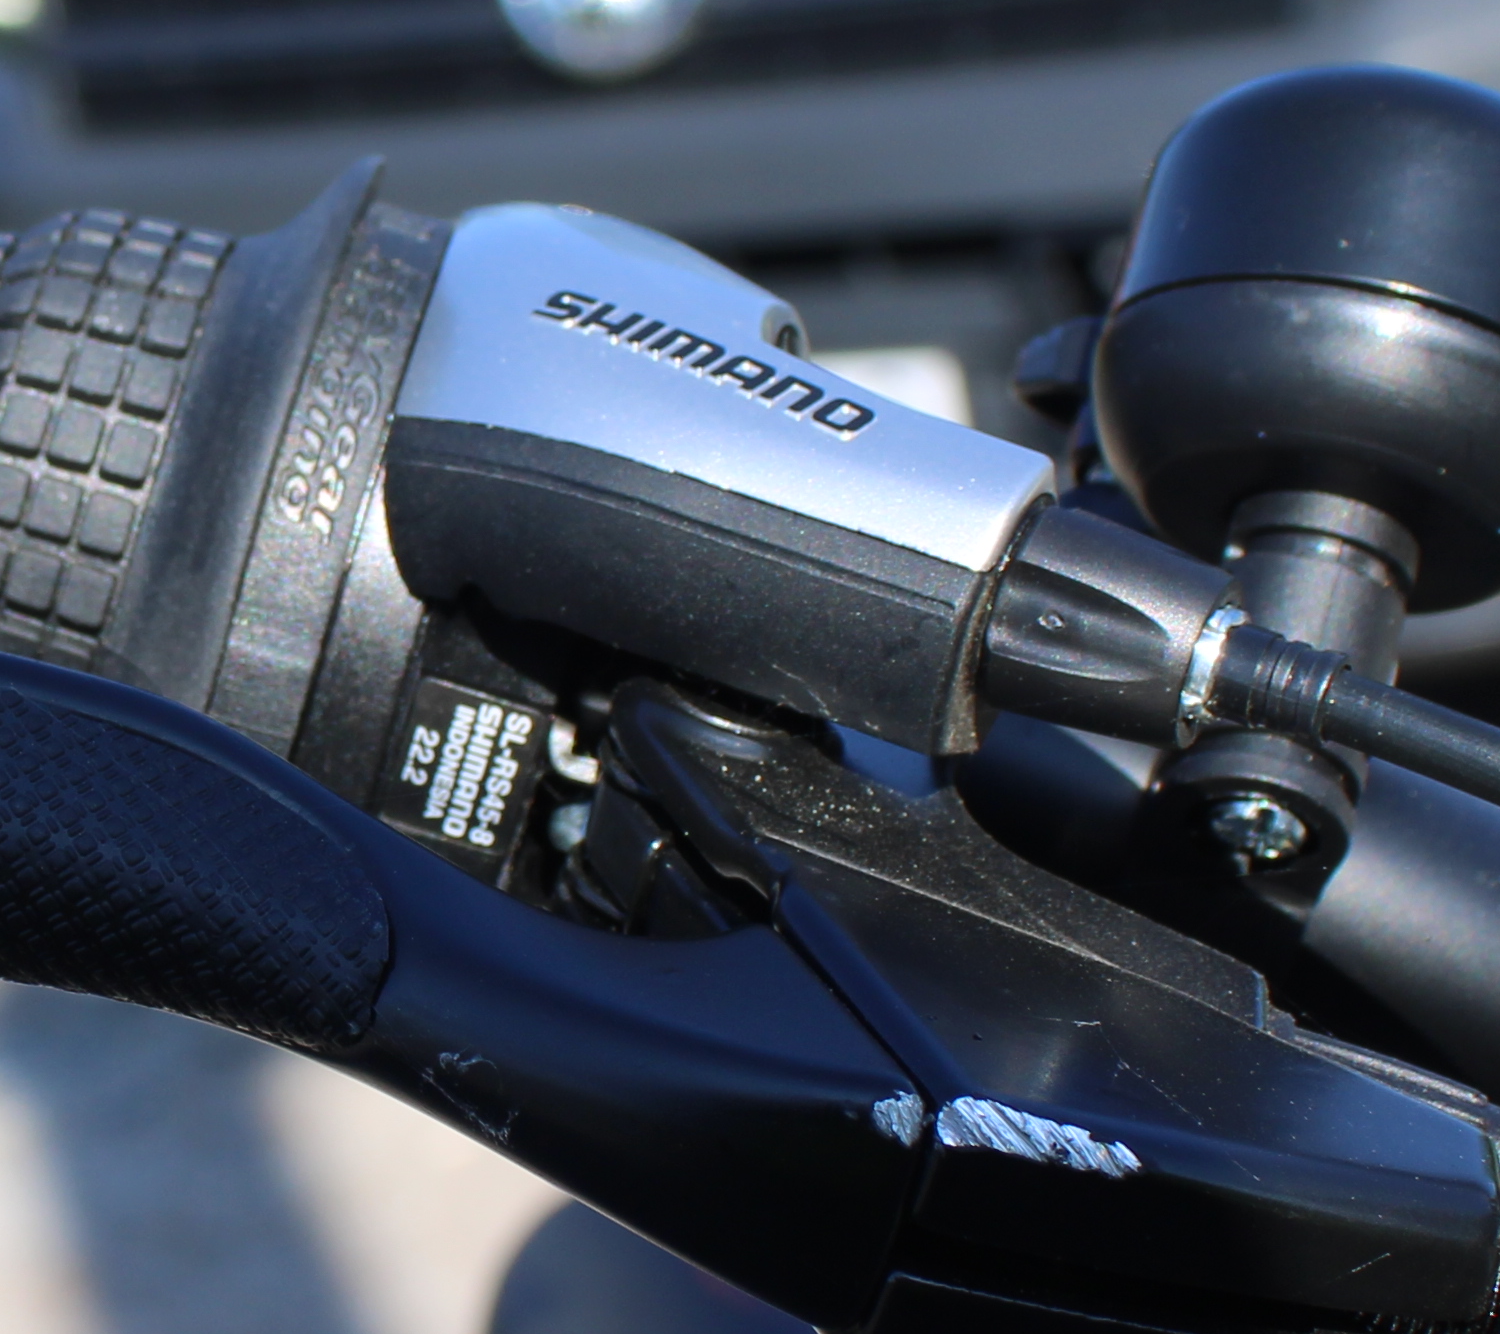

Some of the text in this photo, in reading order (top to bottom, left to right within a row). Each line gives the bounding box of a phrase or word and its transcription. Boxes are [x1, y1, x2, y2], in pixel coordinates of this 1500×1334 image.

[531, 289, 877, 434] SHIMANO
[400, 725, 441, 786] 22.2
[422, 703, 477, 819] INDONESIA
[441, 702, 504, 838] SHIMANO
[467, 712, 533, 847] SL-RS45-8
